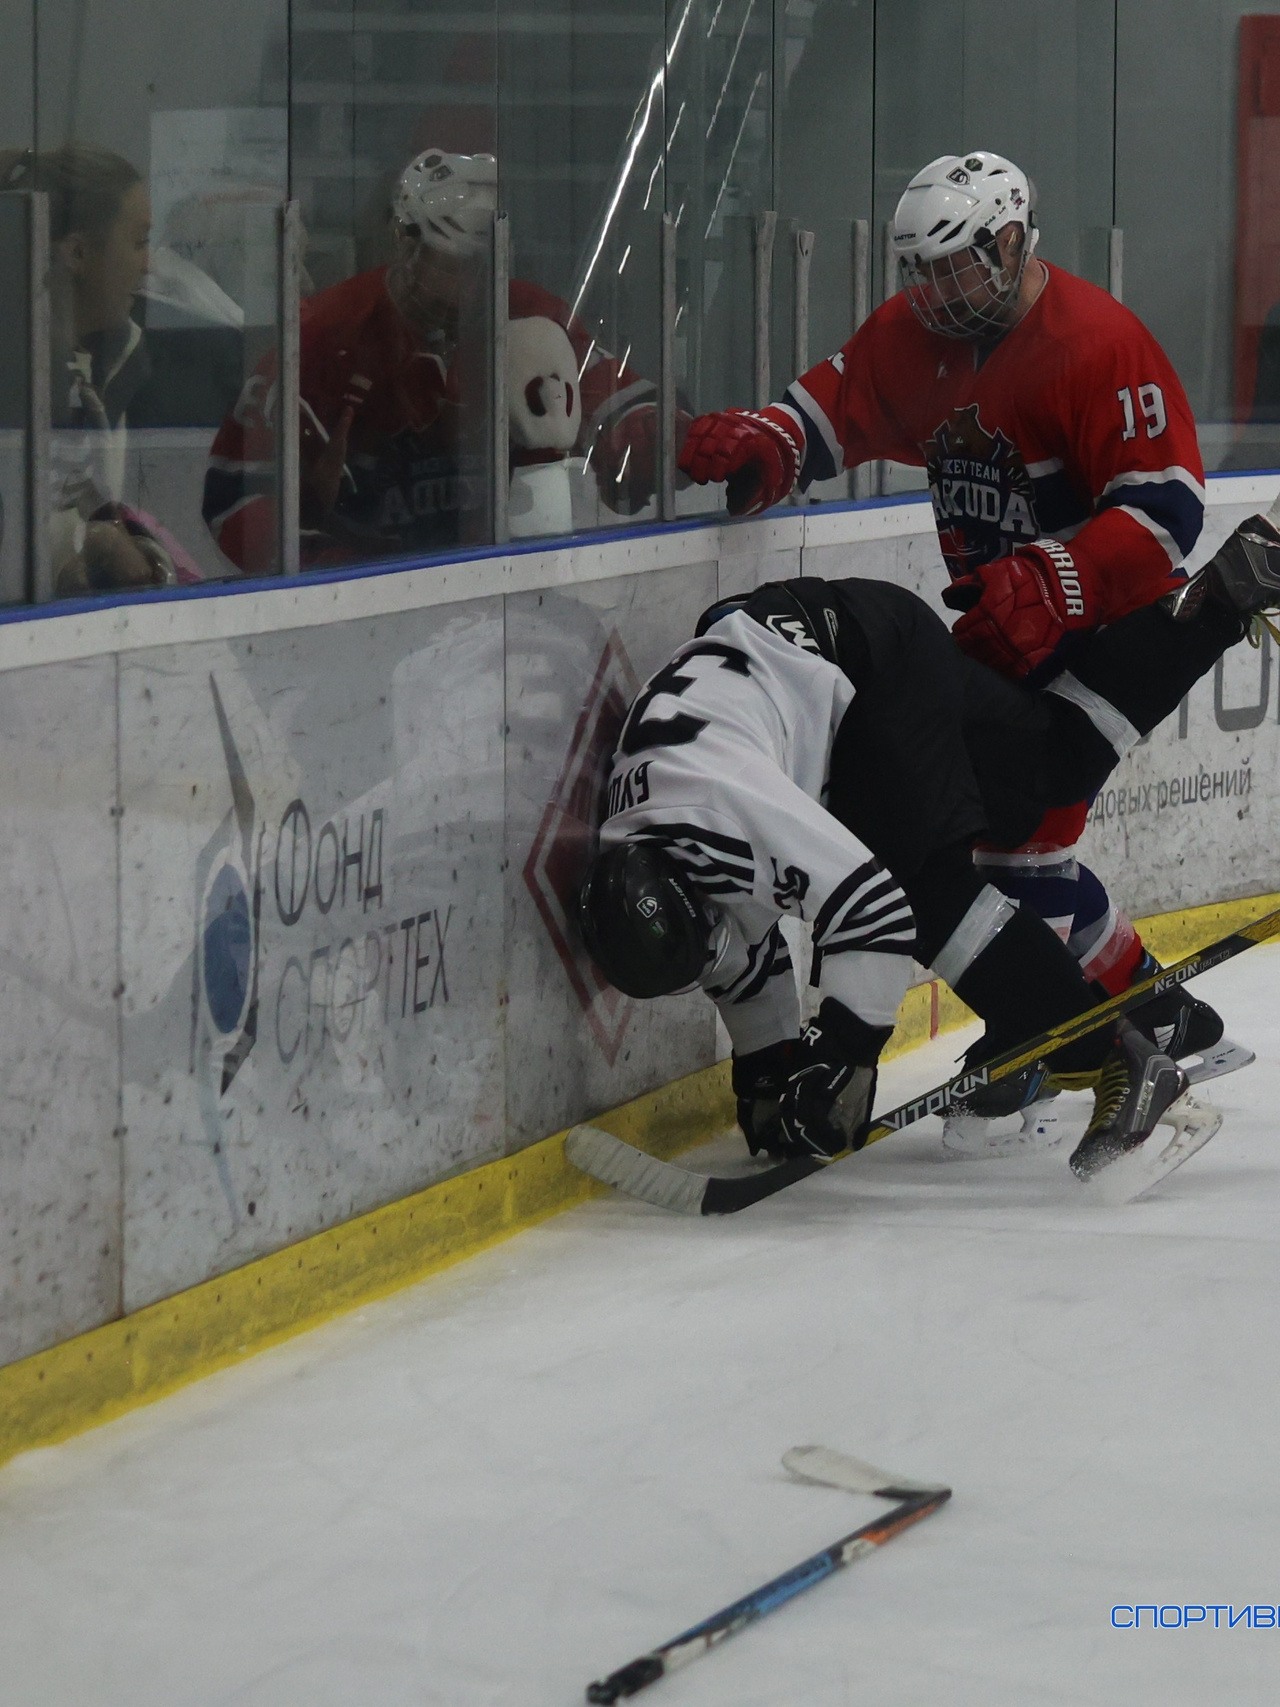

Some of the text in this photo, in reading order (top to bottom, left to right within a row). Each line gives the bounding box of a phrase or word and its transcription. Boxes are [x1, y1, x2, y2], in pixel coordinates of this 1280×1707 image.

[1116, 382, 1168, 442] 19
[969, 461, 1000, 483] TEAM
[1156, 756, 1252, 814] решений
[1154, 961, 1199, 995] NEON
[879, 1066, 989, 1131] VITOKIN
